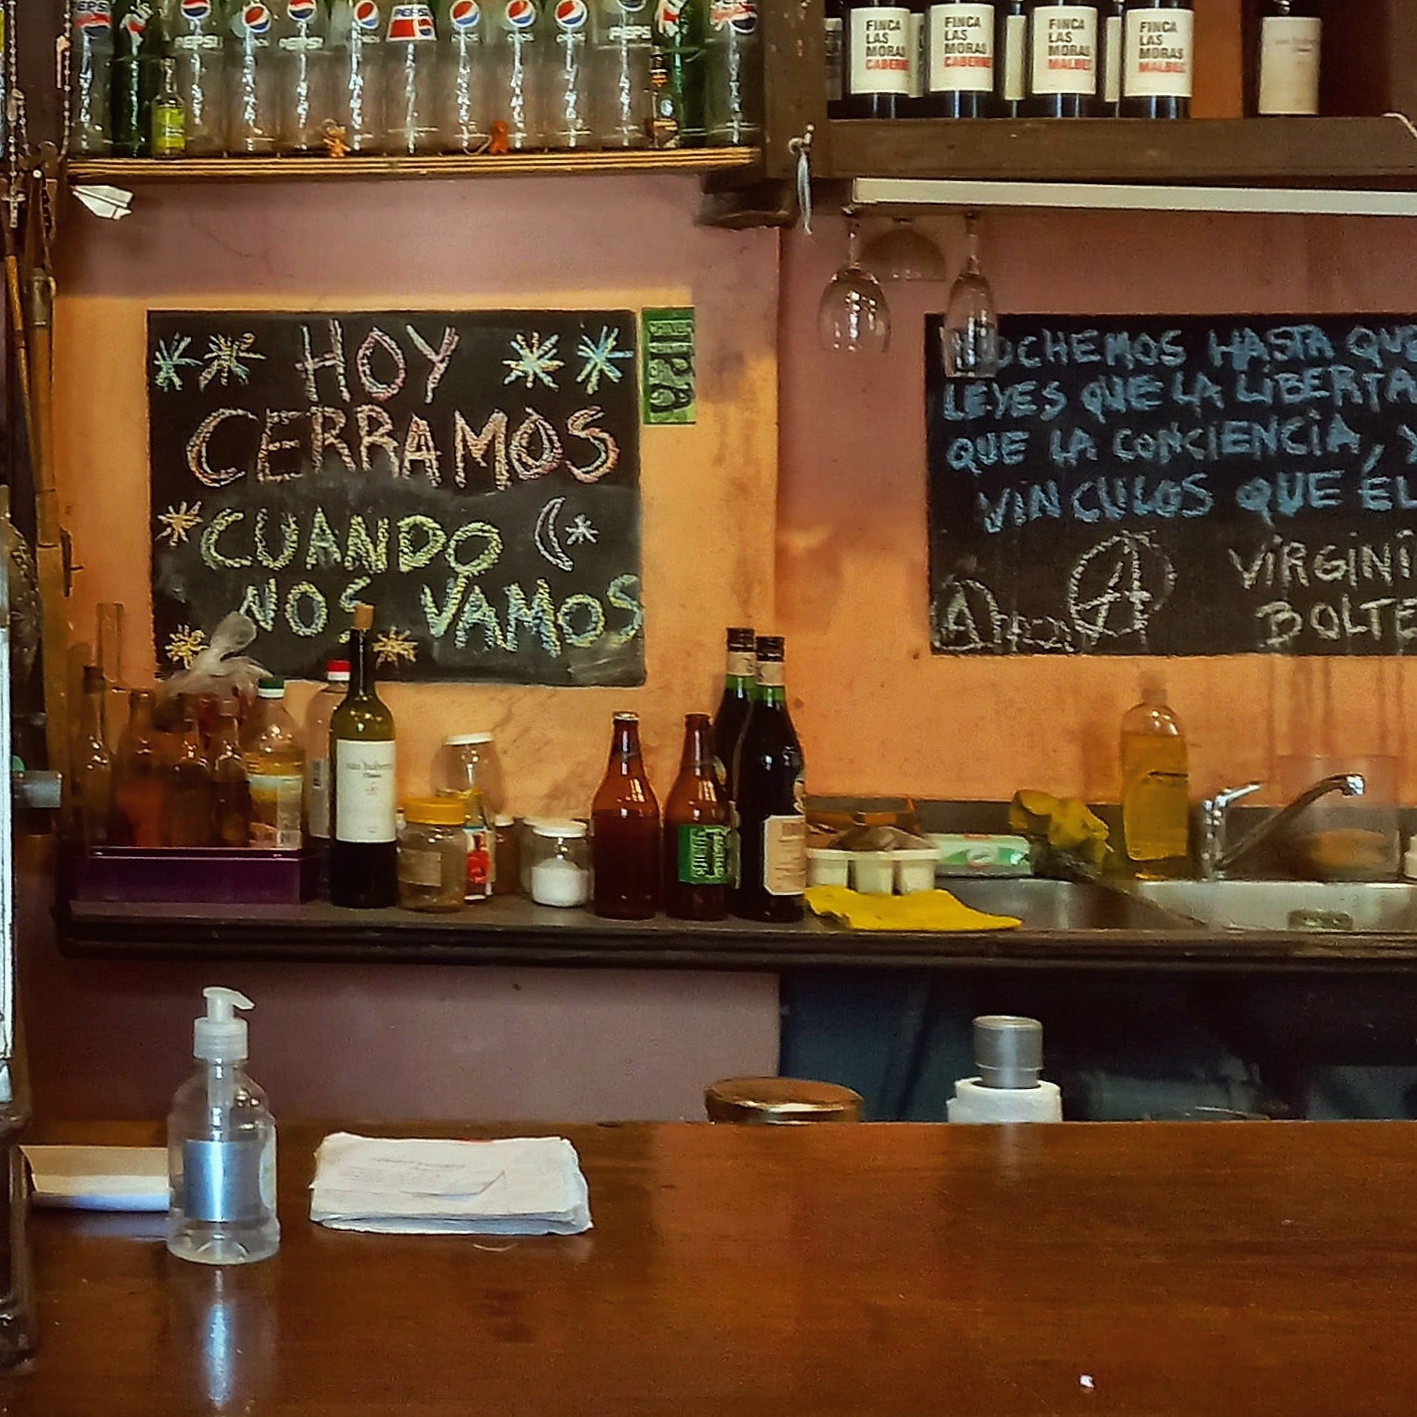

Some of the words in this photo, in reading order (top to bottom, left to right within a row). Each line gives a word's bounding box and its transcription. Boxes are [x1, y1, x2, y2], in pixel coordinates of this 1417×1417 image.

[866, 19, 901, 31] FINCA
[944, 16, 982, 28] FINCA
[1049, 18, 1085, 30] FINCA
[1139, 21, 1178, 33] FINCA
[866, 33, 889, 44] LAS
[944, 30, 968, 41] LAS
[1049, 32, 1073, 43] LAS
[1139, 35, 1163, 46] LAS
[1139, 48, 1184, 59] MORAS
[1208, 325, 1335, 370] HASTA
[296, 319, 459, 405] HOY
[942, 380, 1066, 422] LEYES
[1082, 376, 1165, 423] QUE
[1173, 371, 1224, 409] LA
[186, 405, 622, 491] CERRAMOS
[945, 430, 1029, 477] QUE
[1049, 427, 1098, 467] LA
[1235, 470, 1346, 530] QUE
[199, 505, 504, 575] CUANDO
[419, 568, 645, 659] VAMOS
